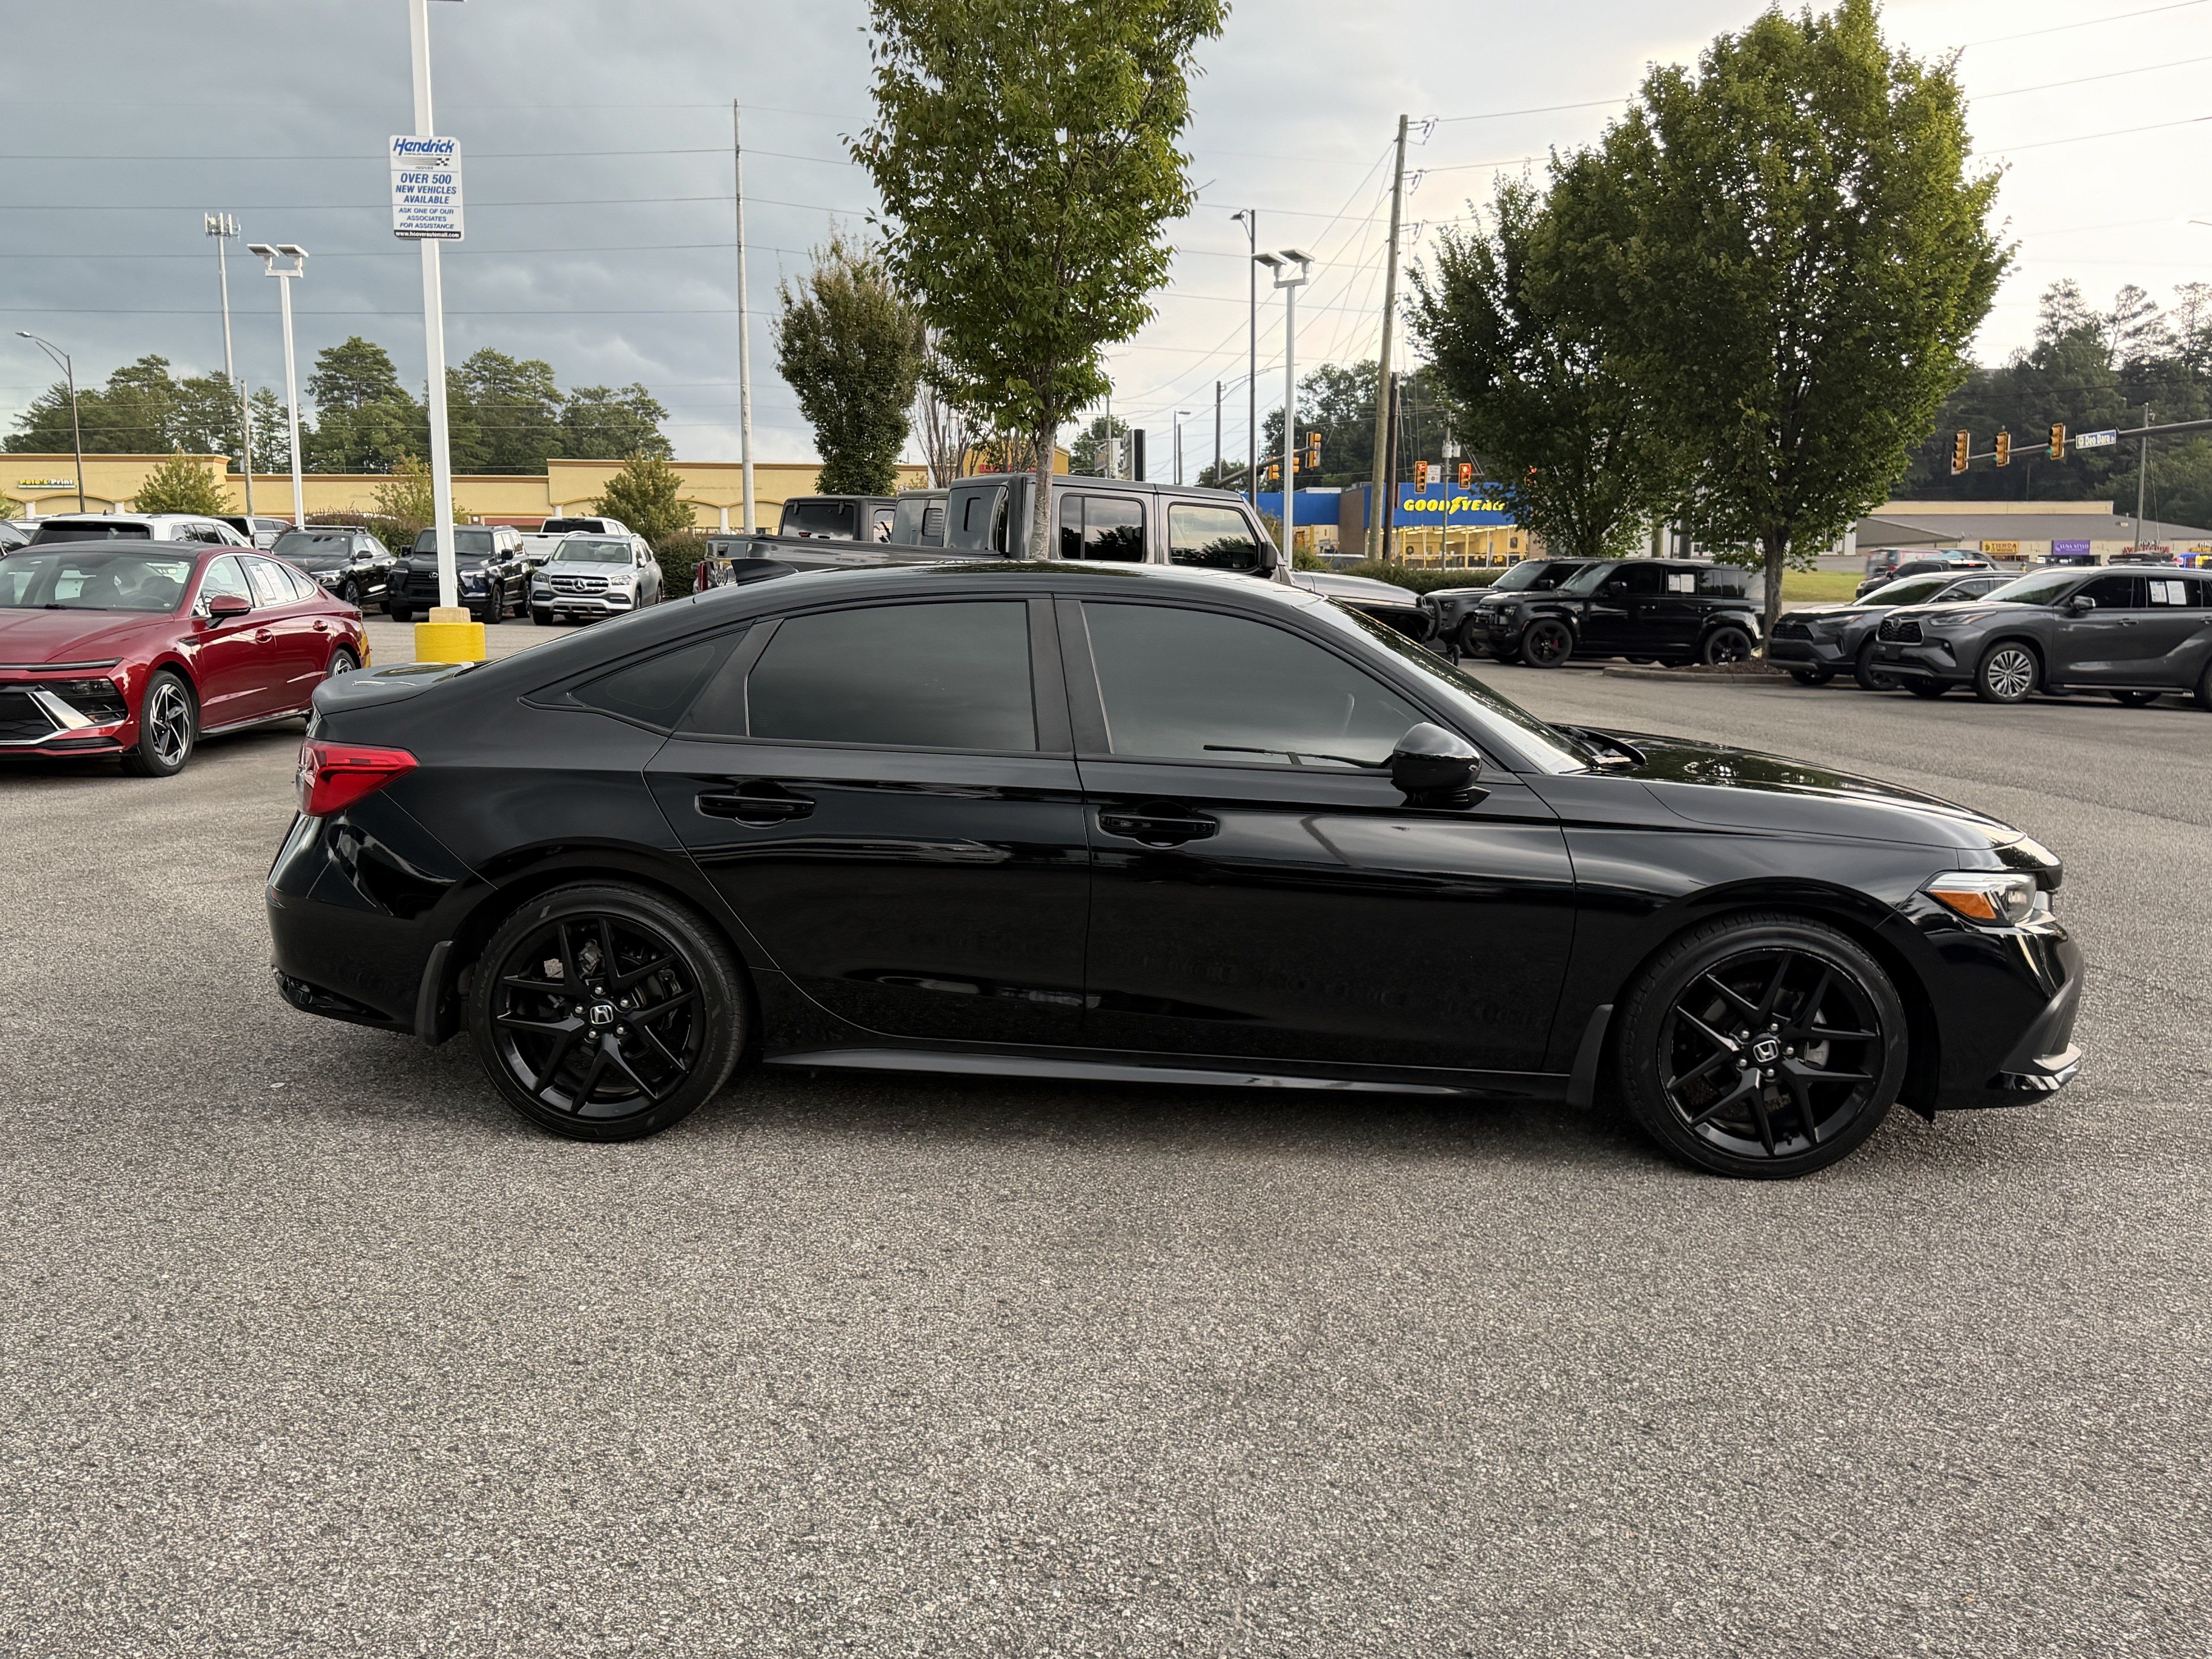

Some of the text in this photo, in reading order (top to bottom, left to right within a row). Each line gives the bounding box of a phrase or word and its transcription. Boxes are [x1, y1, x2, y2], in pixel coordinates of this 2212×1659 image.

[393, 138, 454, 156] Hendrick
[400, 173, 452, 184] OVER 500
[396, 185, 457, 194] NEW VEHICLES
[404, 195, 450, 204] AVAILABLE
